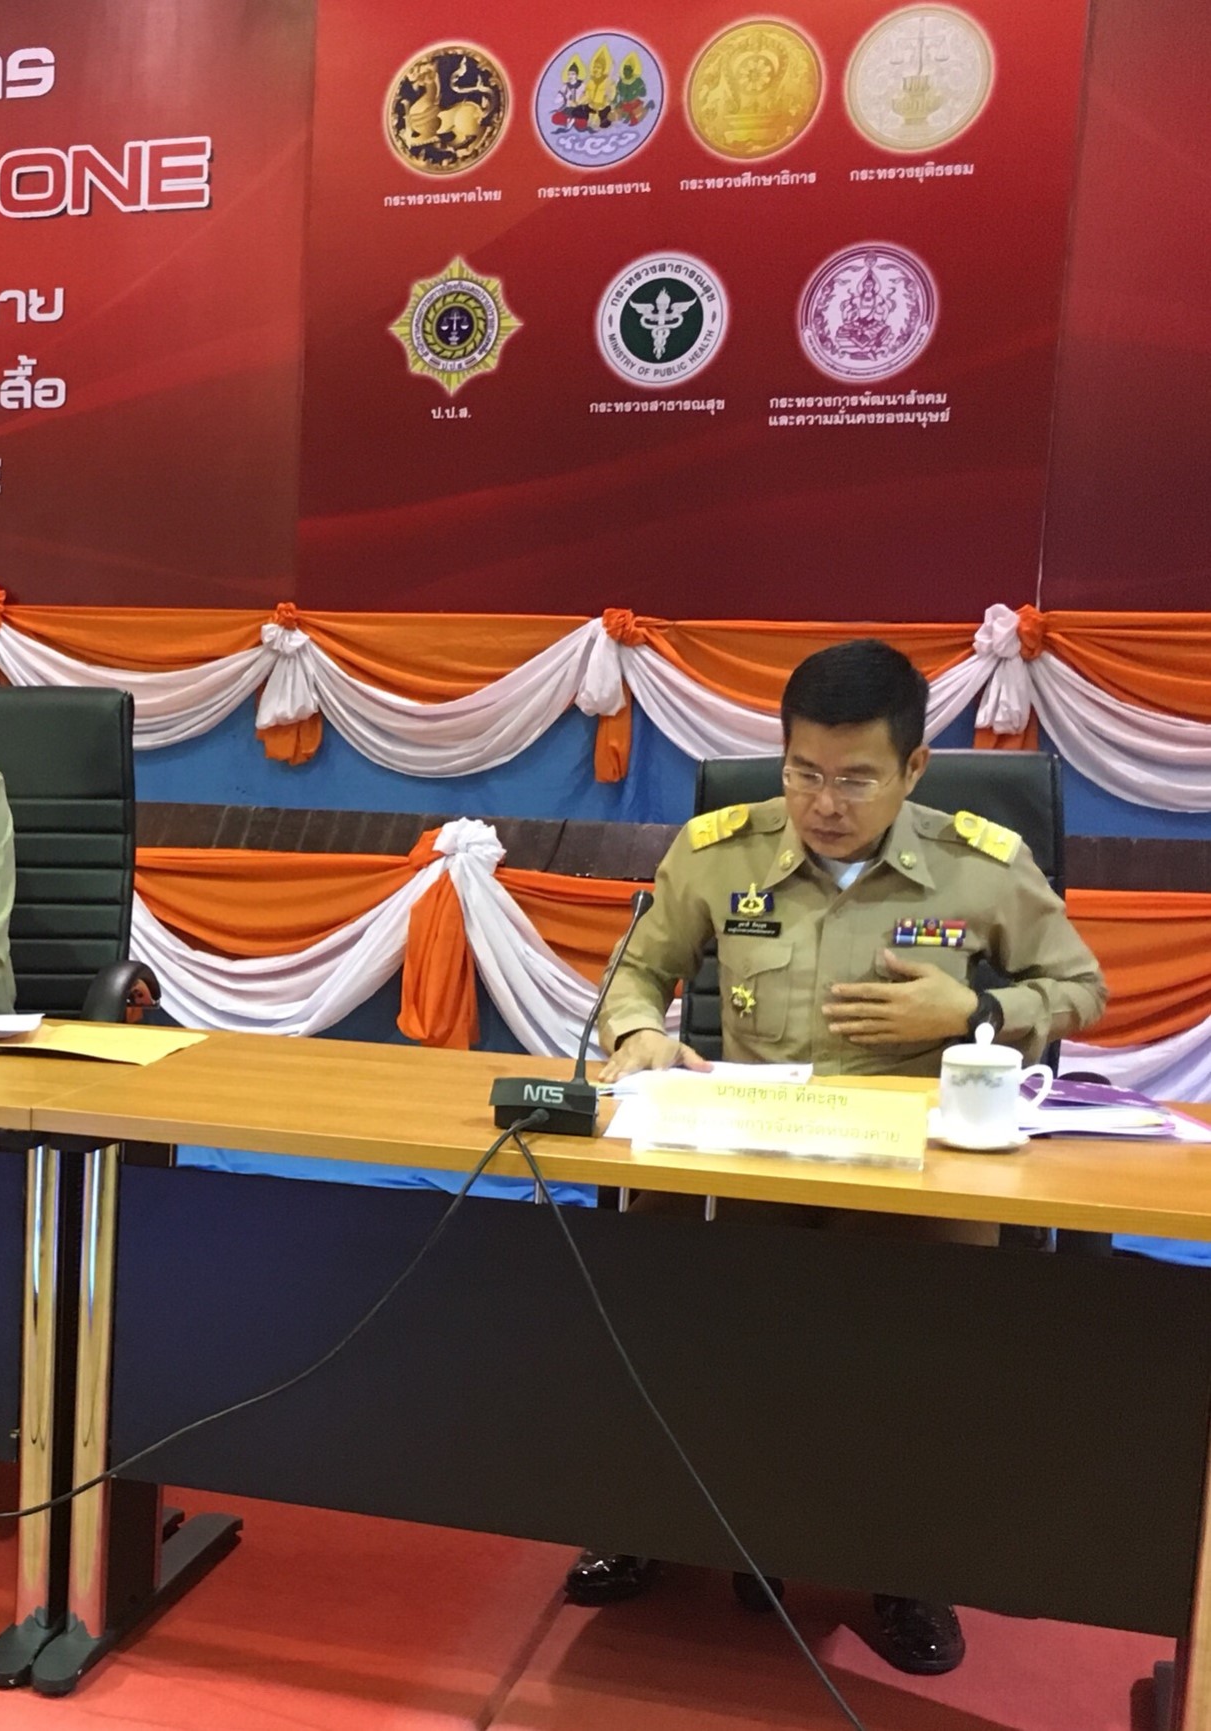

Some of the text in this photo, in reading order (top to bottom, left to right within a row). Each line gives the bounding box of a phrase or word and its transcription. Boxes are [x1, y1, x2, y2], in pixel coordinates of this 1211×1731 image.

[680, 169, 817, 191] กระทรวงศึกษาธิการ
[850, 161, 974, 183] กระทรวงยุติธรรม
[384, 186, 502, 207] กระทรวงมหาดไทย
[537, 180, 651, 199] กระทรวงแรงงาน
[608, 329, 715, 377] MINISTRY OF PUBLIC HEALTH
[589, 398, 725, 416] กระทรวงสาธารณสุข
[769, 390, 947, 409] กระทรวงการพัฒนาสังคม
[768, 406, 951, 429] และความมั่นคงของมนุษย์
